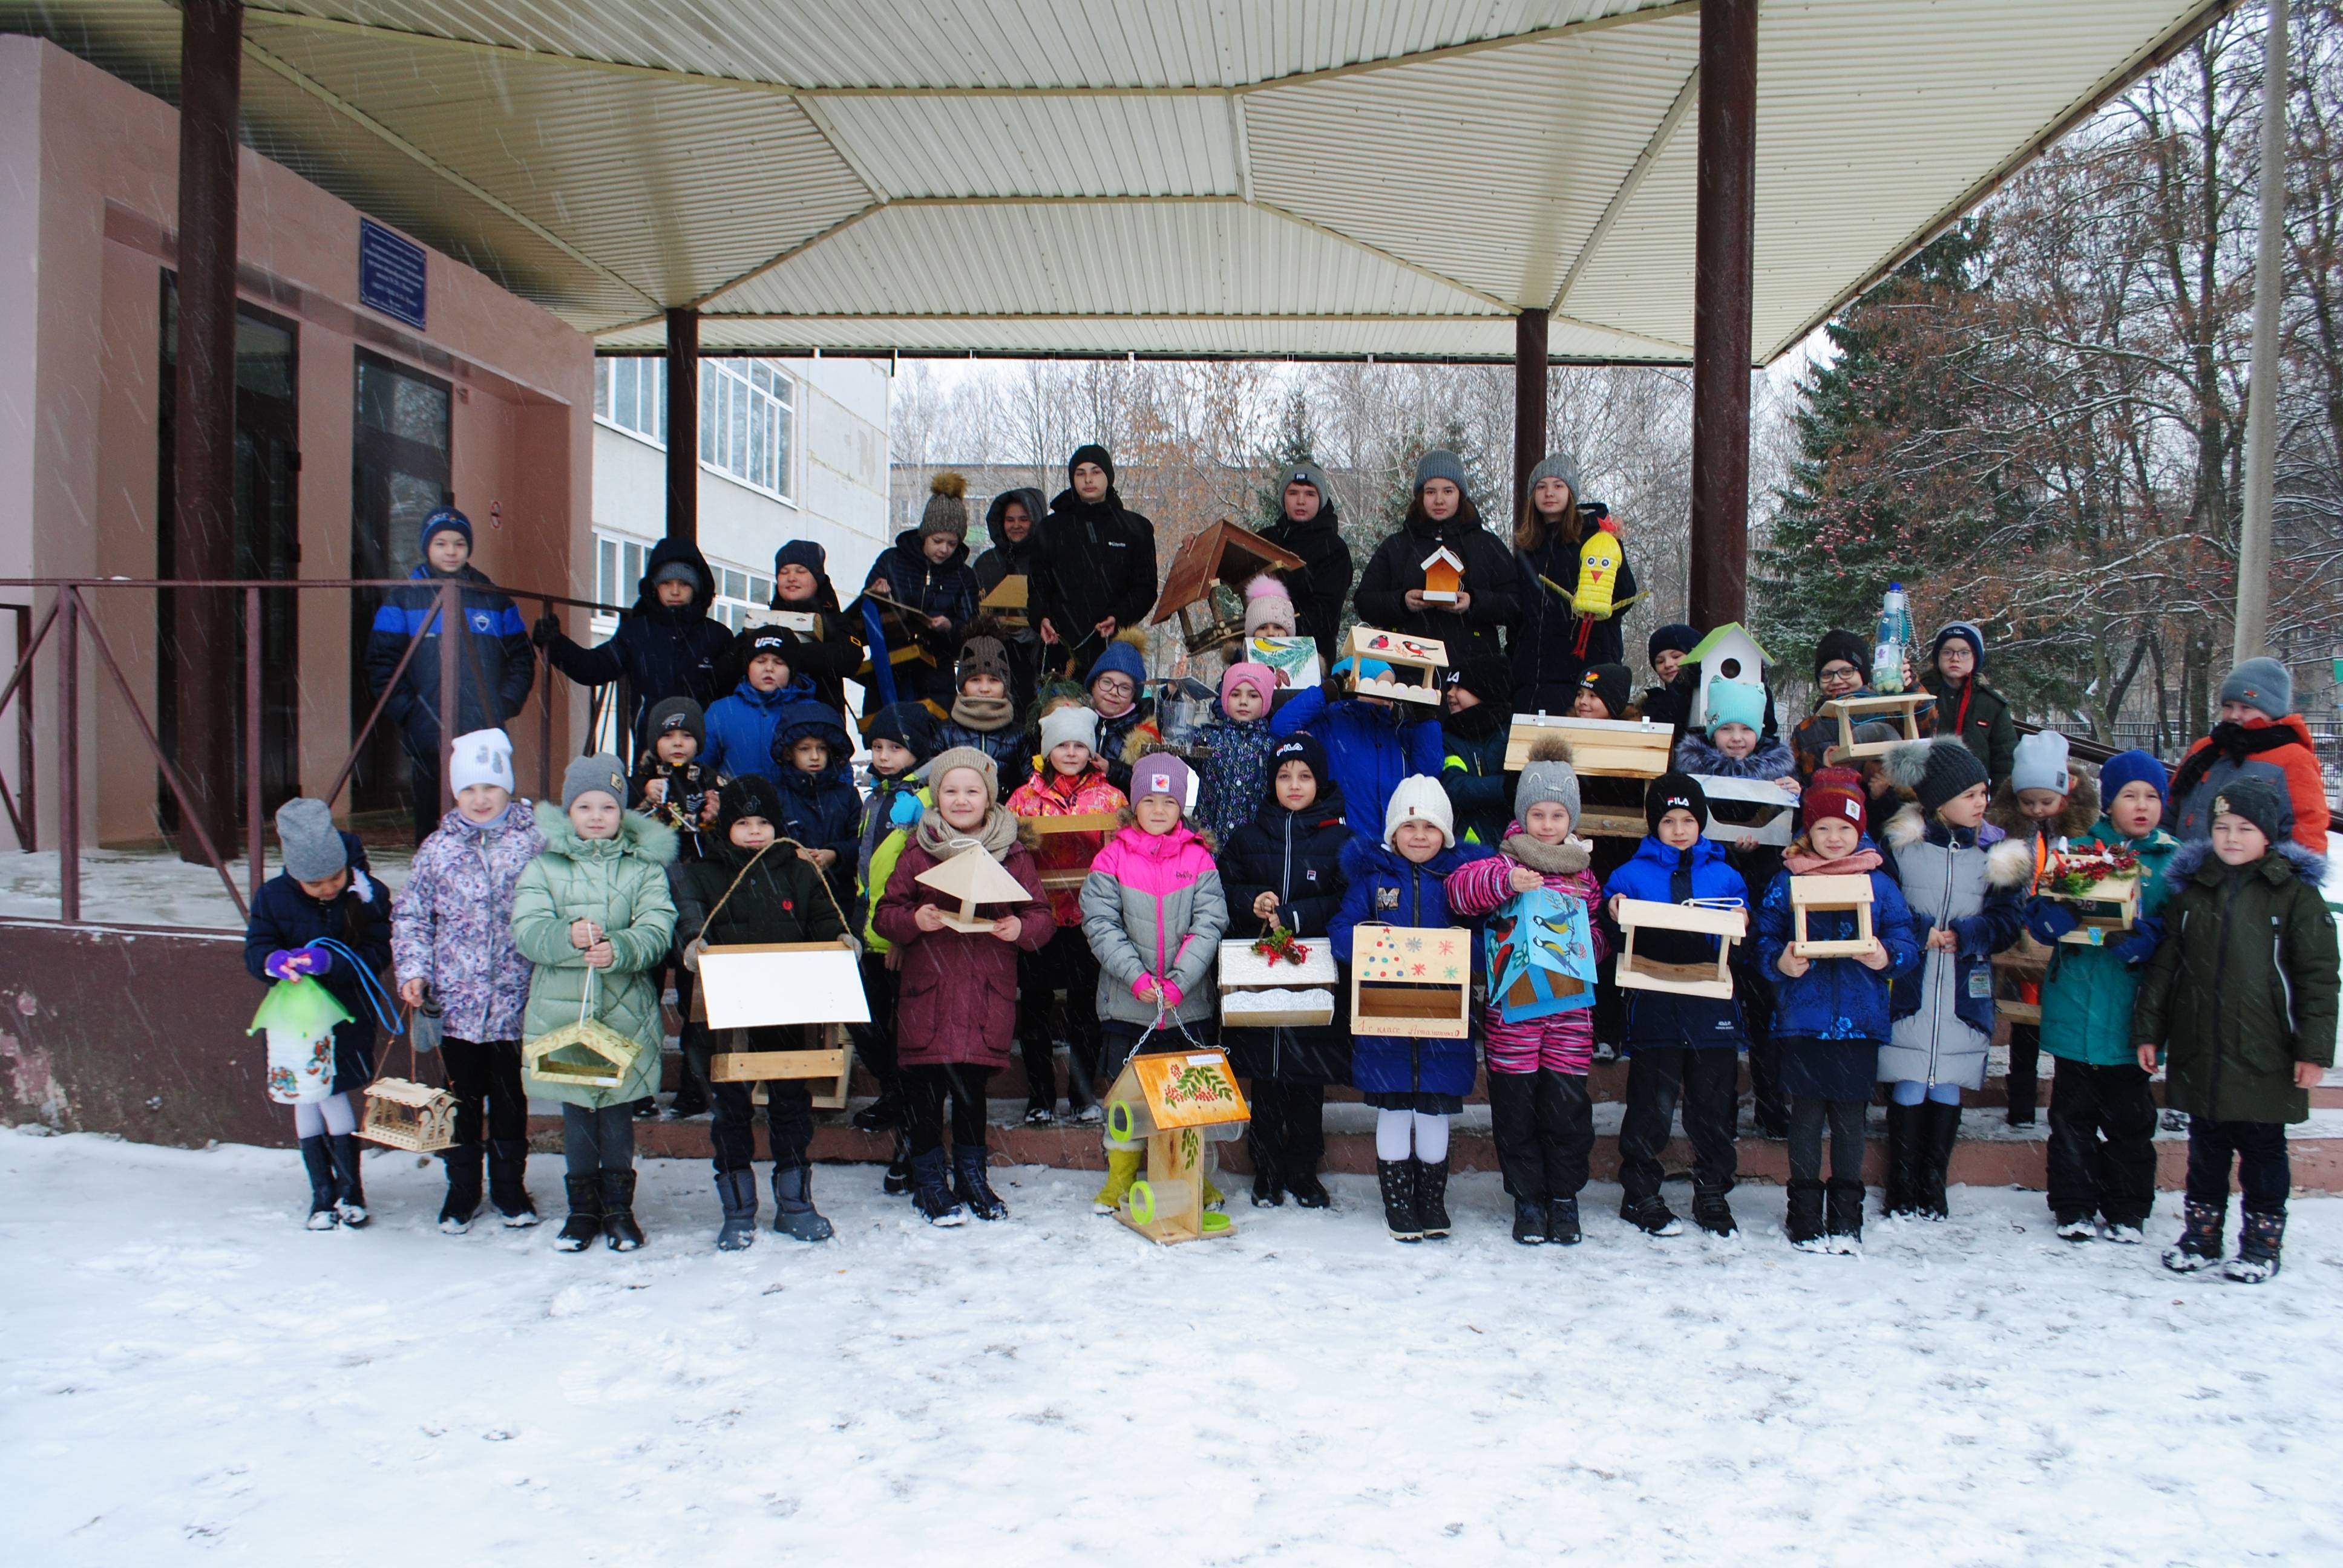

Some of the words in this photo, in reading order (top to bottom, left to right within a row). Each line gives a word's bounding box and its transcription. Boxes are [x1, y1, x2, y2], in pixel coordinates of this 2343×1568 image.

[755, 637, 783, 648] UFC
[1446, 671, 1460, 683] LA
[1276, 742, 1303, 757] FILA
[1667, 796, 1689, 806] FILA
